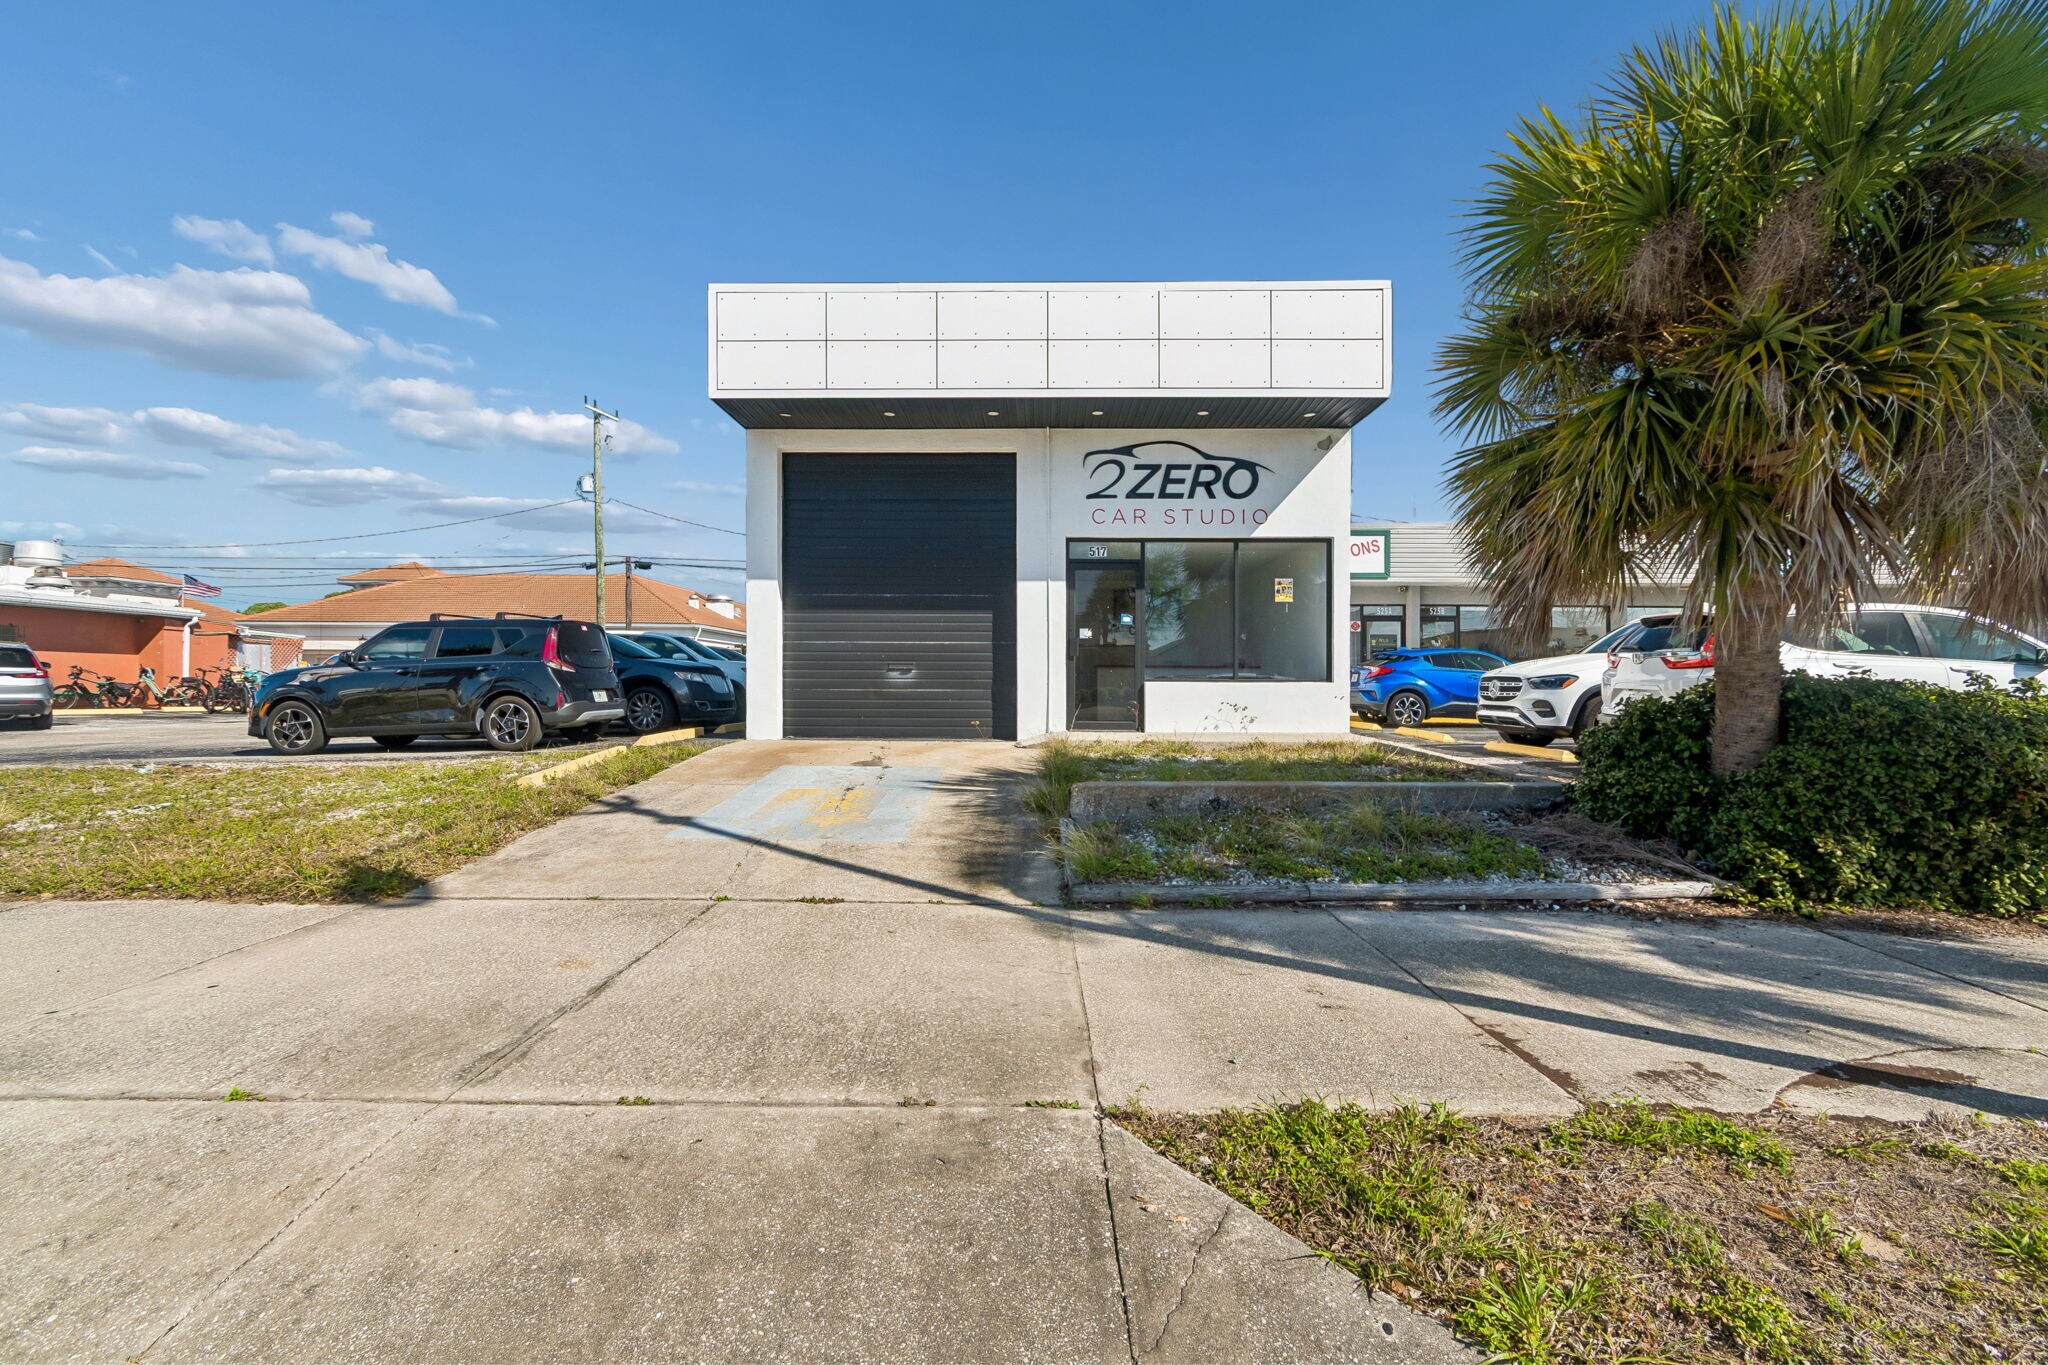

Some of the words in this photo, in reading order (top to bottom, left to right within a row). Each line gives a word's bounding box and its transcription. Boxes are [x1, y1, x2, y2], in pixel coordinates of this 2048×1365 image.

[1091, 508, 1147, 525] CAR
[1164, 508, 1269, 525] STUDIO
[1089, 546, 1107, 557] 517
[1350, 539, 1381, 557] ONS
[1376, 607, 1392, 615] 525A
